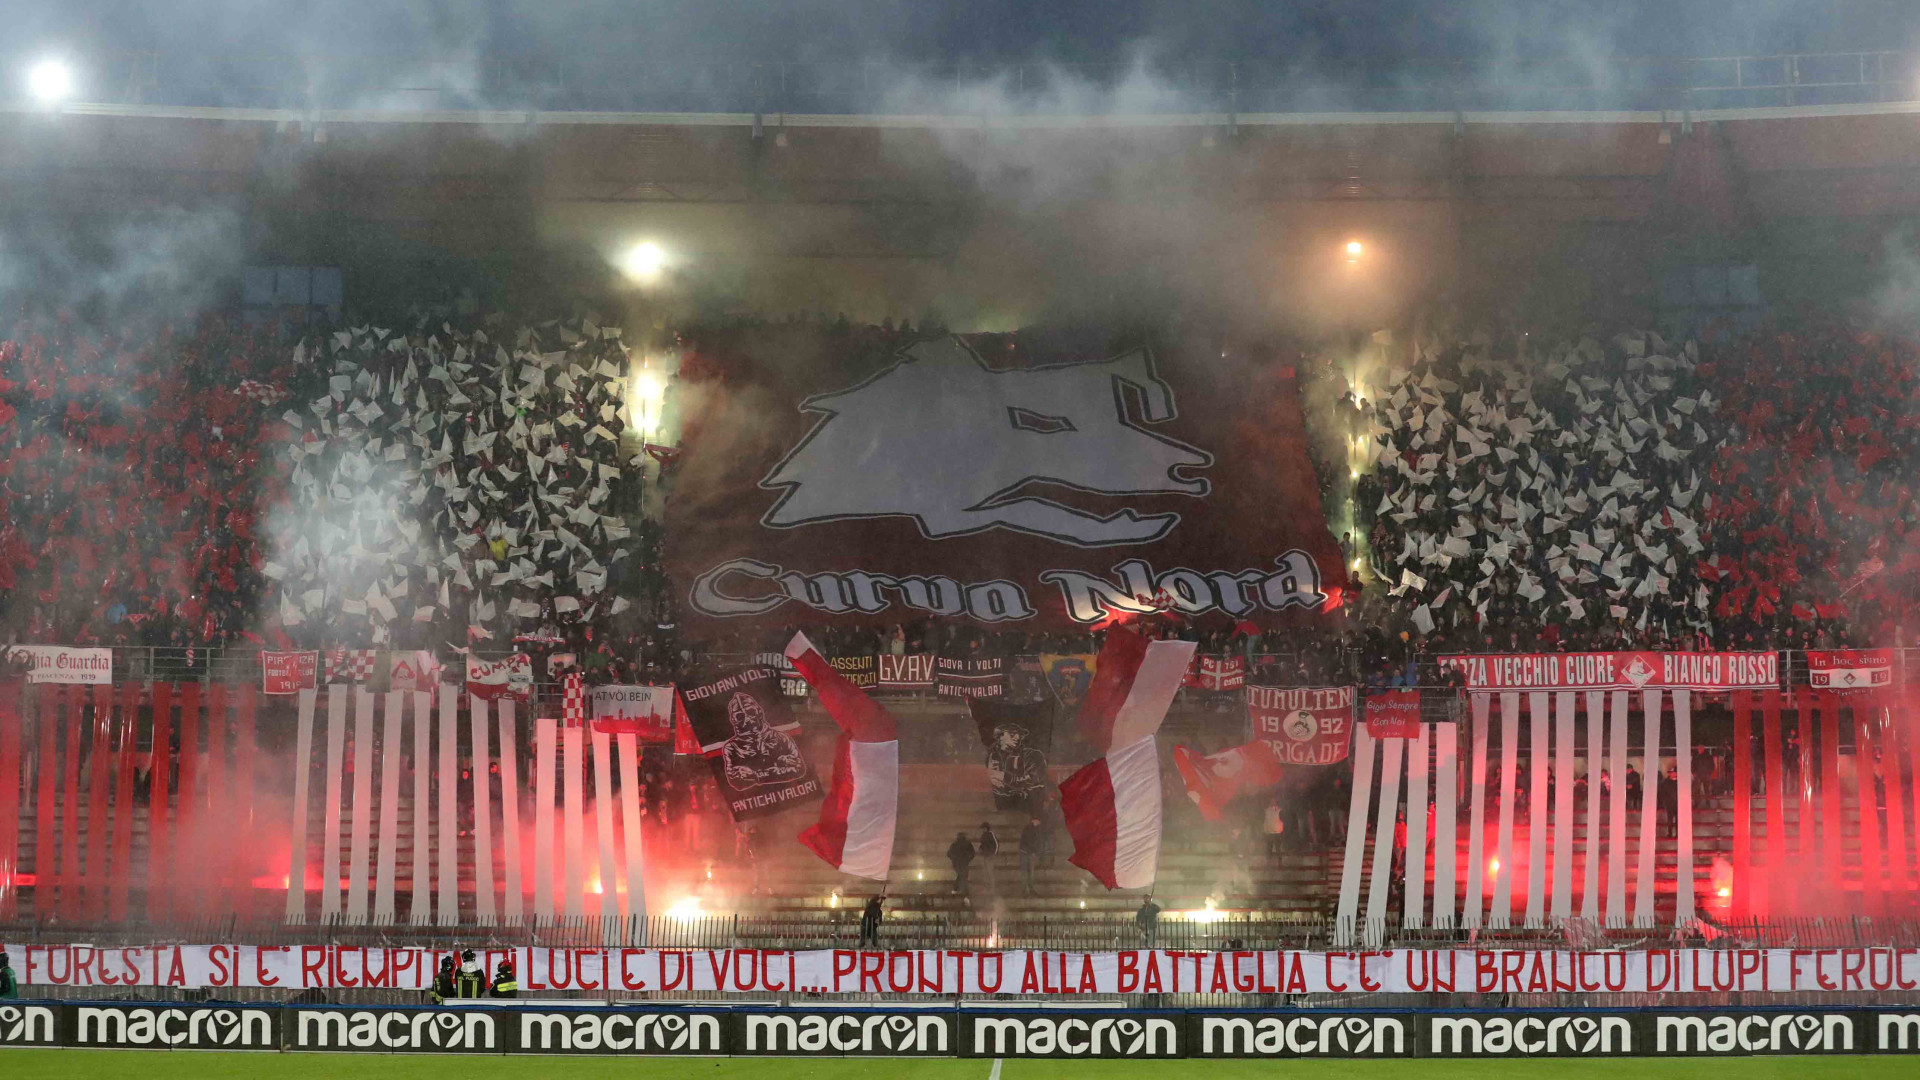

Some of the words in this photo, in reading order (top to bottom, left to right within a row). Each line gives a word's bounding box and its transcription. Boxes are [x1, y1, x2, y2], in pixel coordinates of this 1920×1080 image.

[690, 557, 1038, 624] Curva
[1039, 548, 1328, 624] Nord
[56, 653, 109, 670] Guardia
[830, 656, 873, 670] ASSENTI
[976, 657, 1001, 671] VOLTI
[1493, 656, 1559, 686] VECCHIO
[1565, 654, 1615, 685] CUORE
[1664, 654, 1723, 684] BIANCO
[1729, 654, 1777, 683] ROSSO
[1832, 655, 1854, 666] hoc
[595, 691, 608, 700] AT
[629, 691, 652, 702] BEIN
[685, 676, 738, 702] GIOVANI
[738, 669, 776, 684] VOLTI
[972, 684, 1002, 698] VALORI
[1250, 687, 1353, 711] TUMULTEN
[1260, 716, 1279, 733] 19
[1320, 718, 1344, 735] 92
[732, 793, 777, 813] ANTICHI
[777, 780, 817, 802] VALORI
[25, 945, 186, 985] FORESTA
[833, 950, 1004, 994] PRONTO
[1021, 951, 1098, 994] ALLA
[1117, 950, 1308, 995] BATTAGLIA
[1406, 950, 1456, 993] UN
[1476, 950, 1627, 993] BRANCO
[78, 1007, 272, 1045] macron
[298, 1010, 495, 1048] macron
[521, 1012, 720, 1050] macron
[746, 1014, 948, 1051] macron
[974, 1017, 1177, 1054] macron
[1203, 1016, 1404, 1054] macron
[1431, 1016, 1632, 1053] macron
[1656, 1014, 1854, 1052] macron
